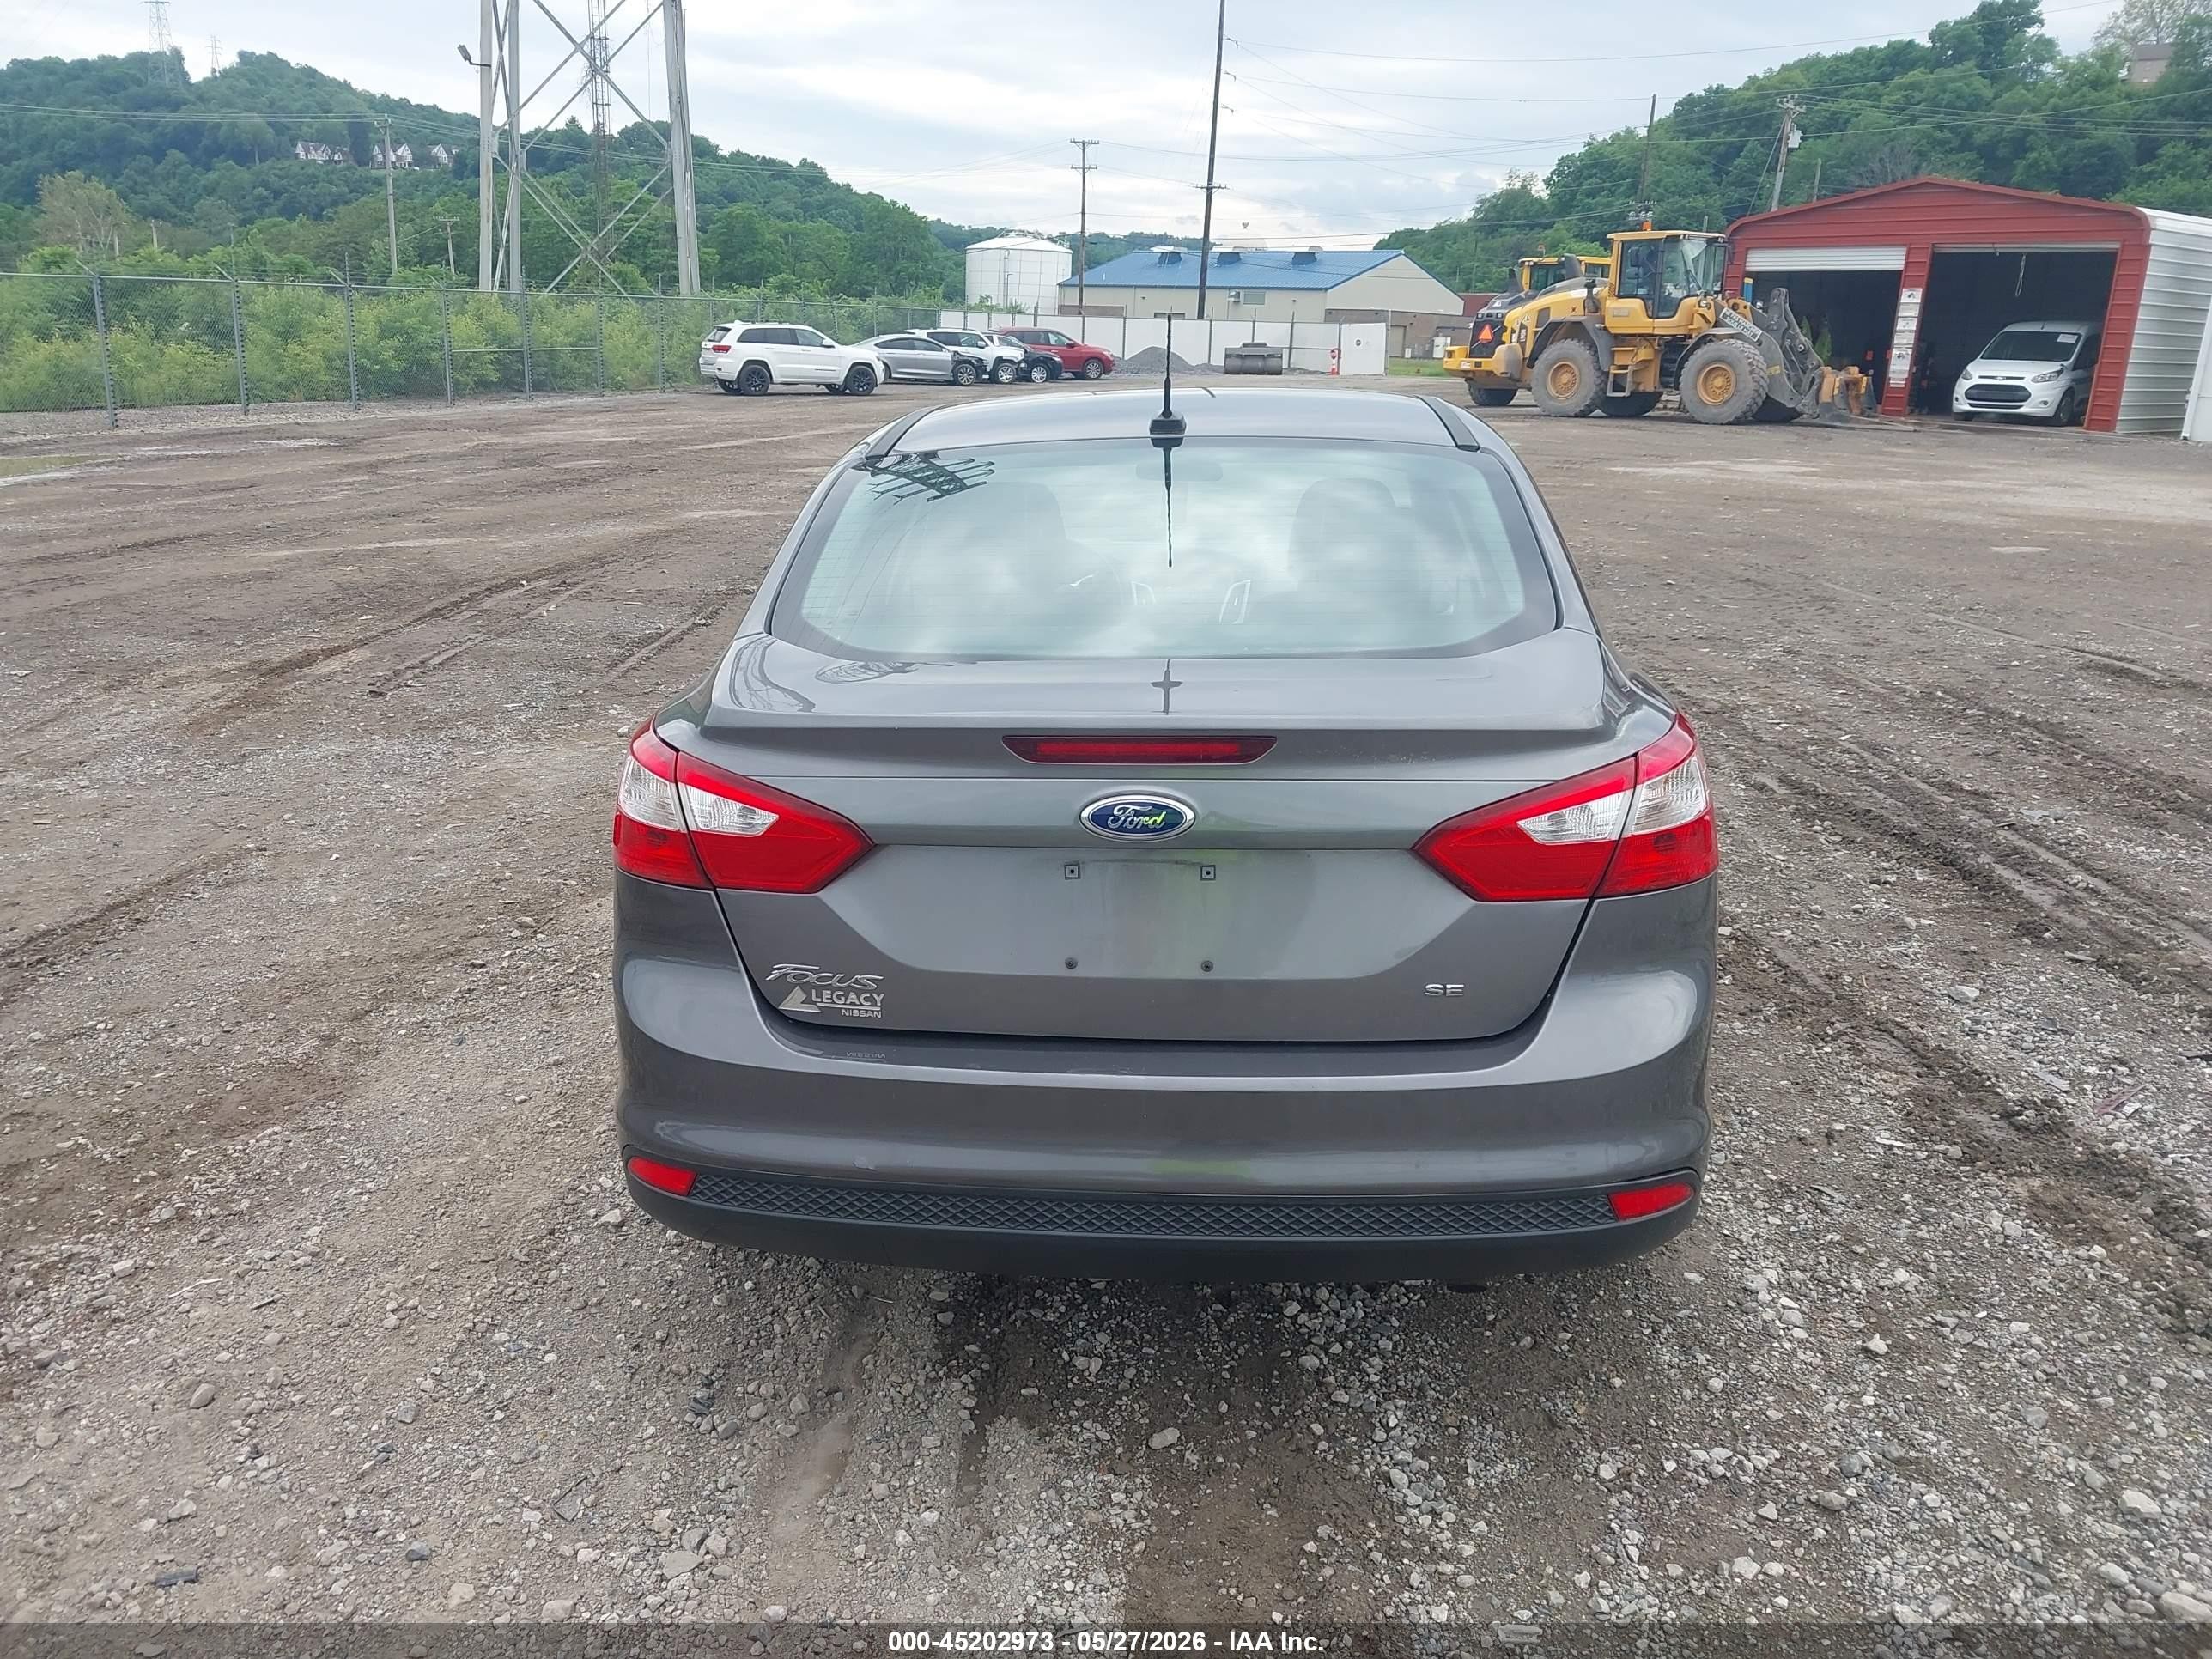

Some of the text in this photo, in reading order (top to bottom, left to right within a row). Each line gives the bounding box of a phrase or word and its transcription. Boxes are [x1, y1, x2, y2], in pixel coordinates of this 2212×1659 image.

[1107, 805, 1166, 829] Ford
[811, 988, 884, 1006] LEGACY
[1425, 984, 1464, 996] SE
[841, 1009, 882, 1018] NISSAN
